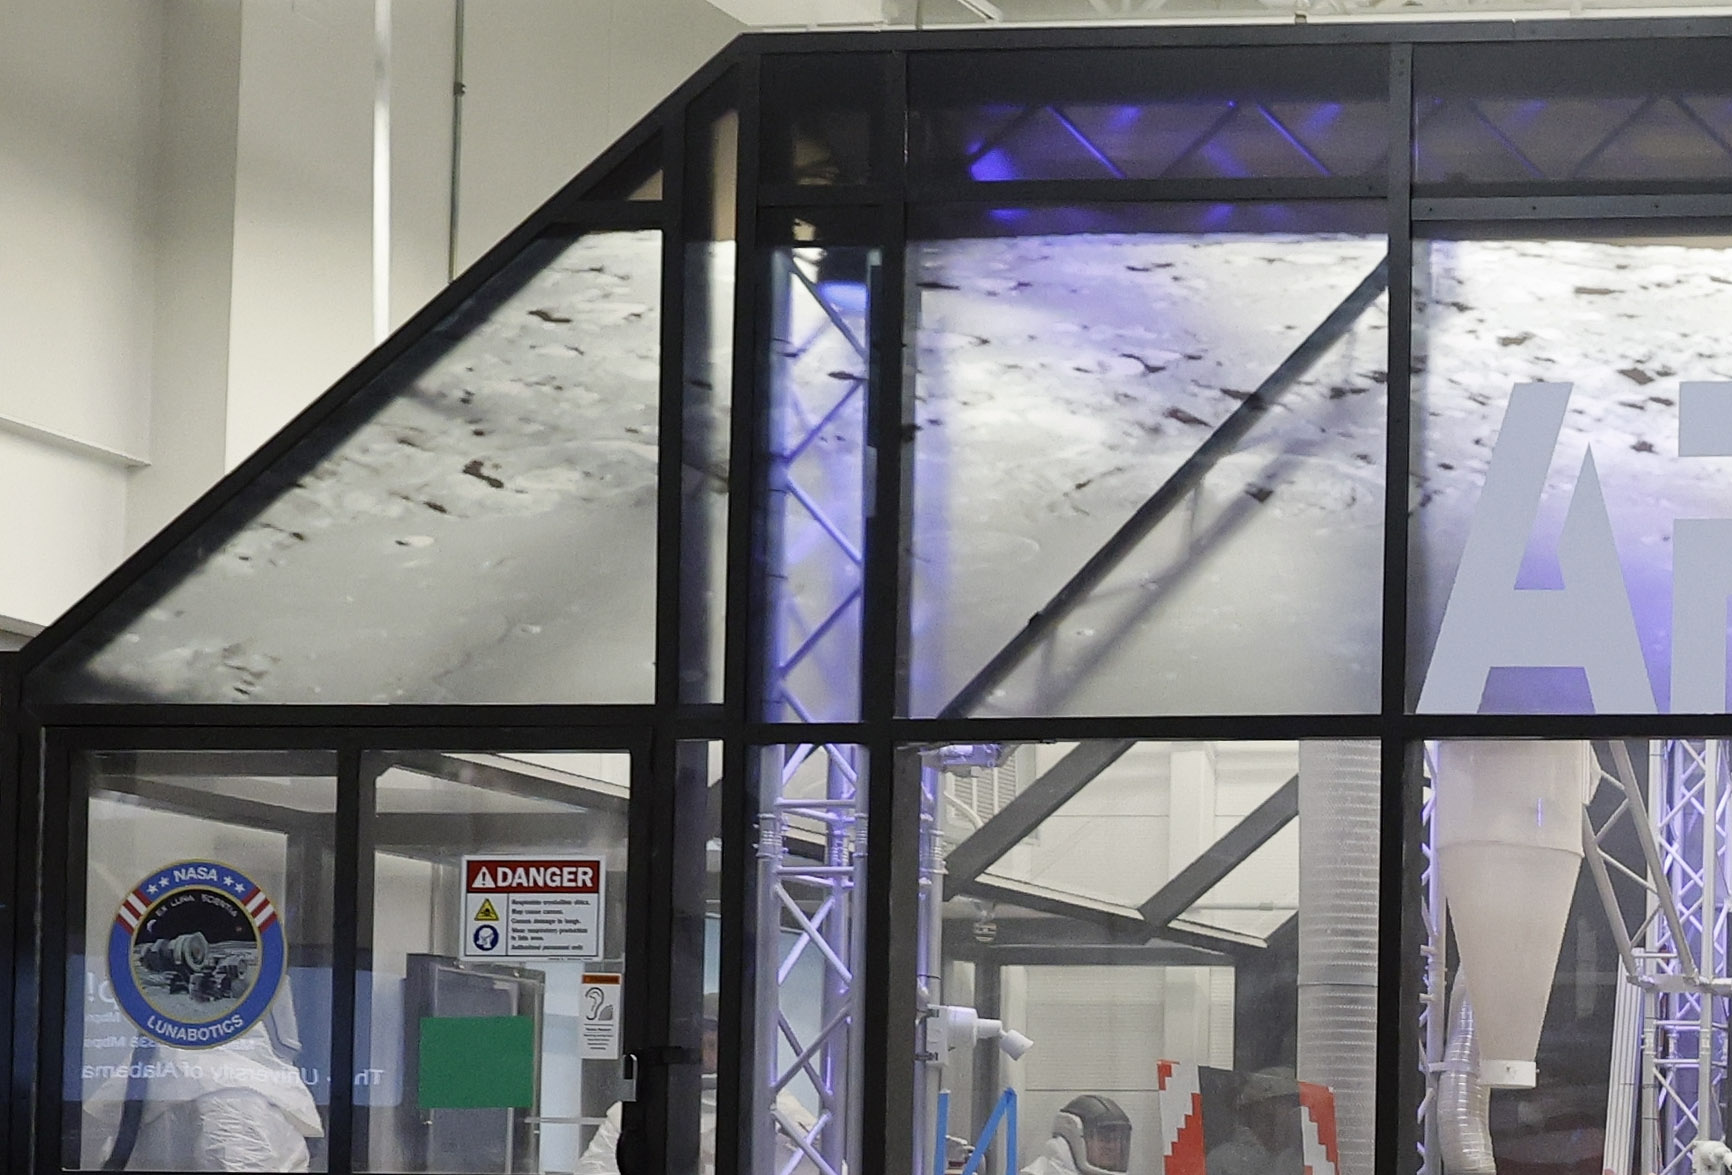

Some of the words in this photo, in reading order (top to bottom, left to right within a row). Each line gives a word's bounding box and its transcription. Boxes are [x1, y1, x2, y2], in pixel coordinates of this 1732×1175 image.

[173, 867, 218, 882] NASA
[496, 866, 593, 888] DANGER
[146, 1015, 244, 1042] LUNABOTICS
